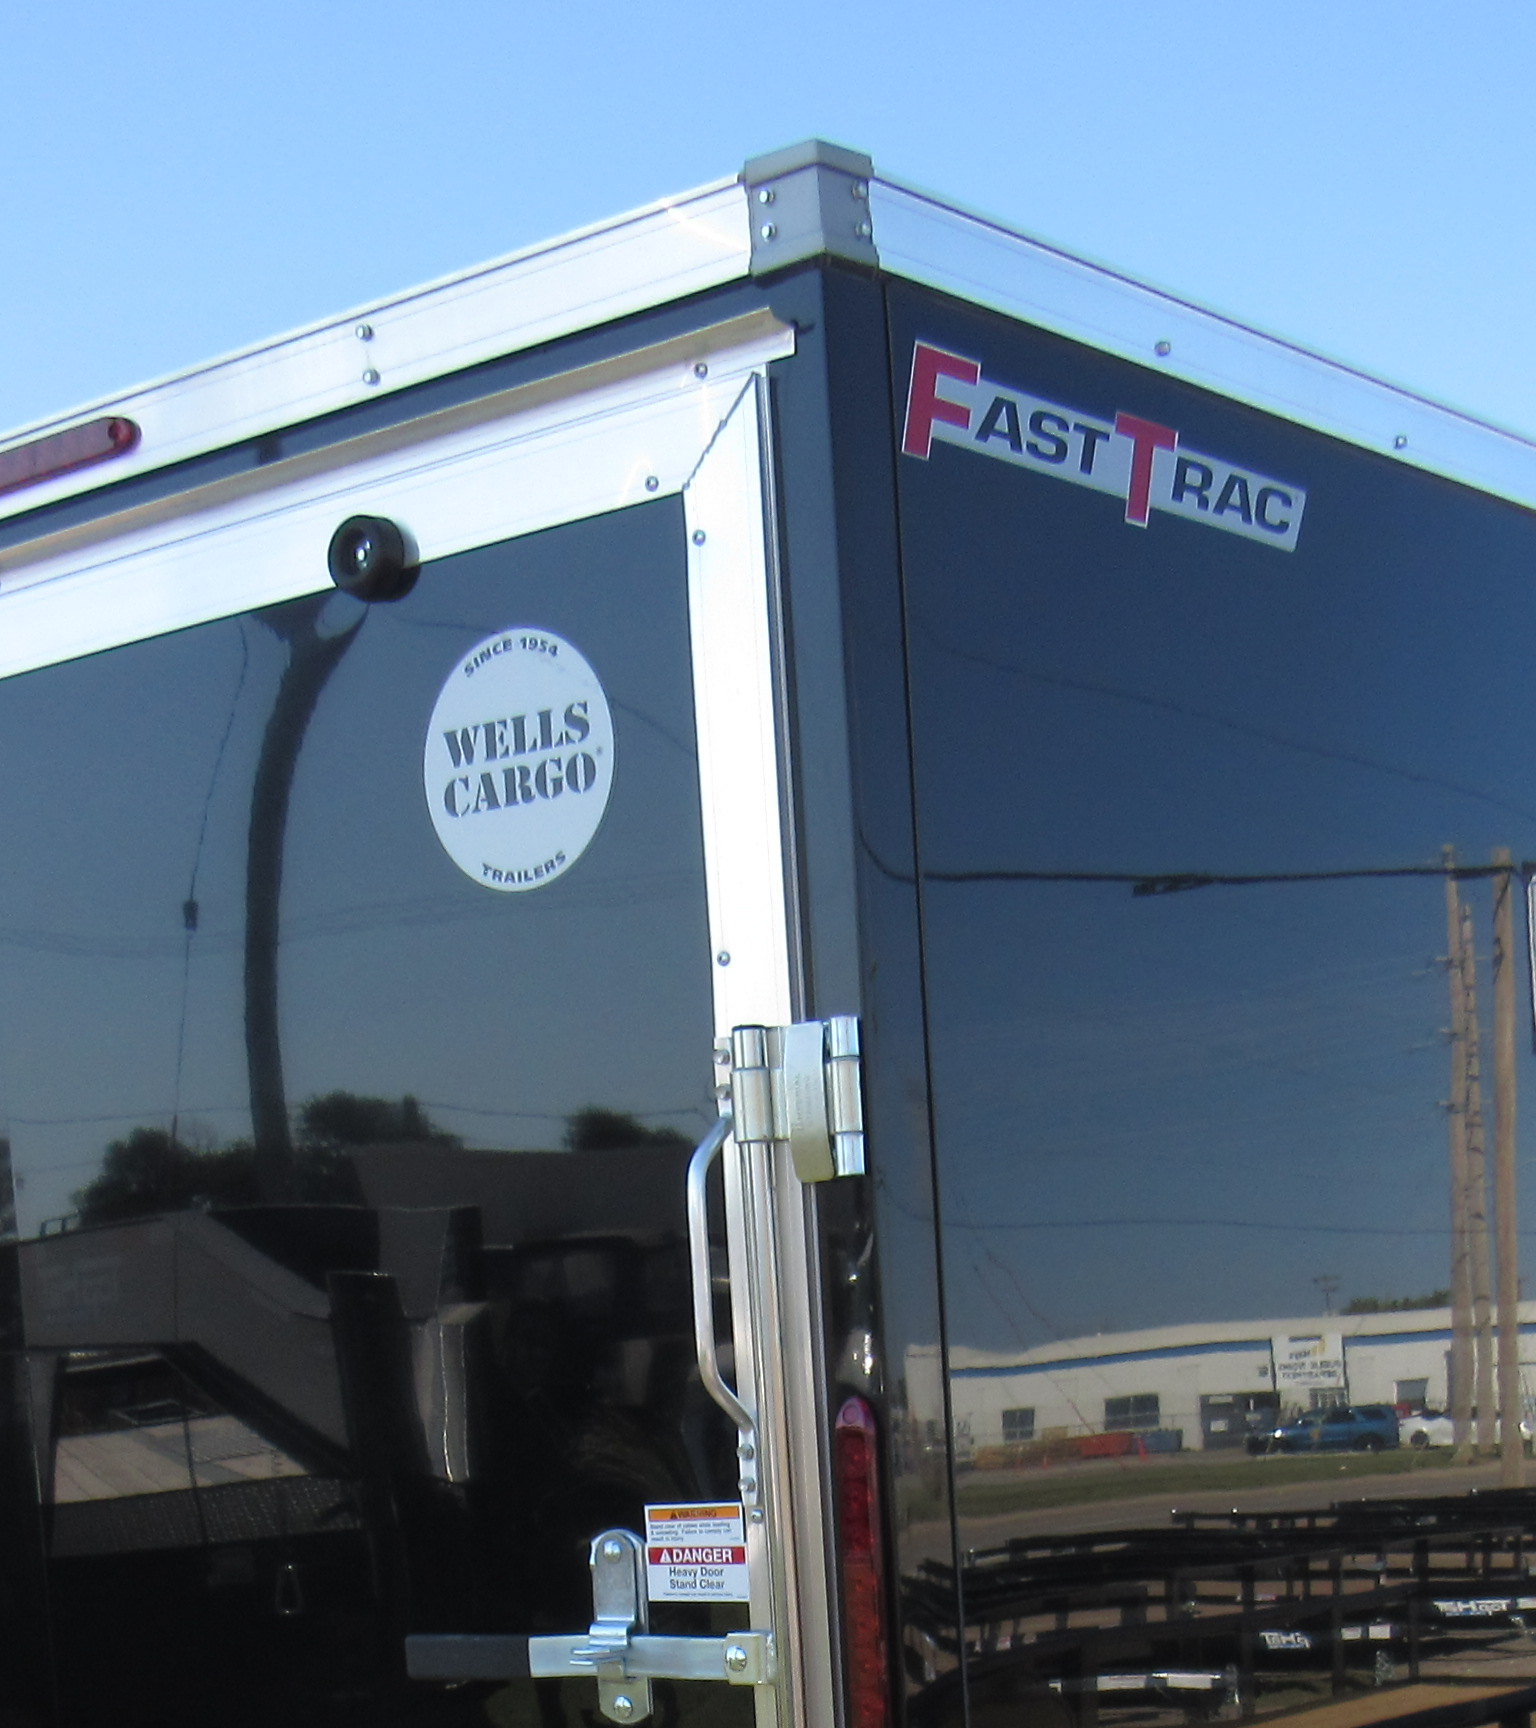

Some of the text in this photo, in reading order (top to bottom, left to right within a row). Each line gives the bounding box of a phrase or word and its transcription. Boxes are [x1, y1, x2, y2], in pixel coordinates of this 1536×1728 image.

[464, 636, 558, 677] SINCE 1954
[442, 700, 591, 768] WELLS
[443, 752, 596, 818] CARGO
[481, 851, 567, 884] TRAILERS
[669, 1566, 724, 1578] Heavy Door
[672, 1548, 733, 1563] DANGER
[670, 1579, 725, 1589] Stand Clear
